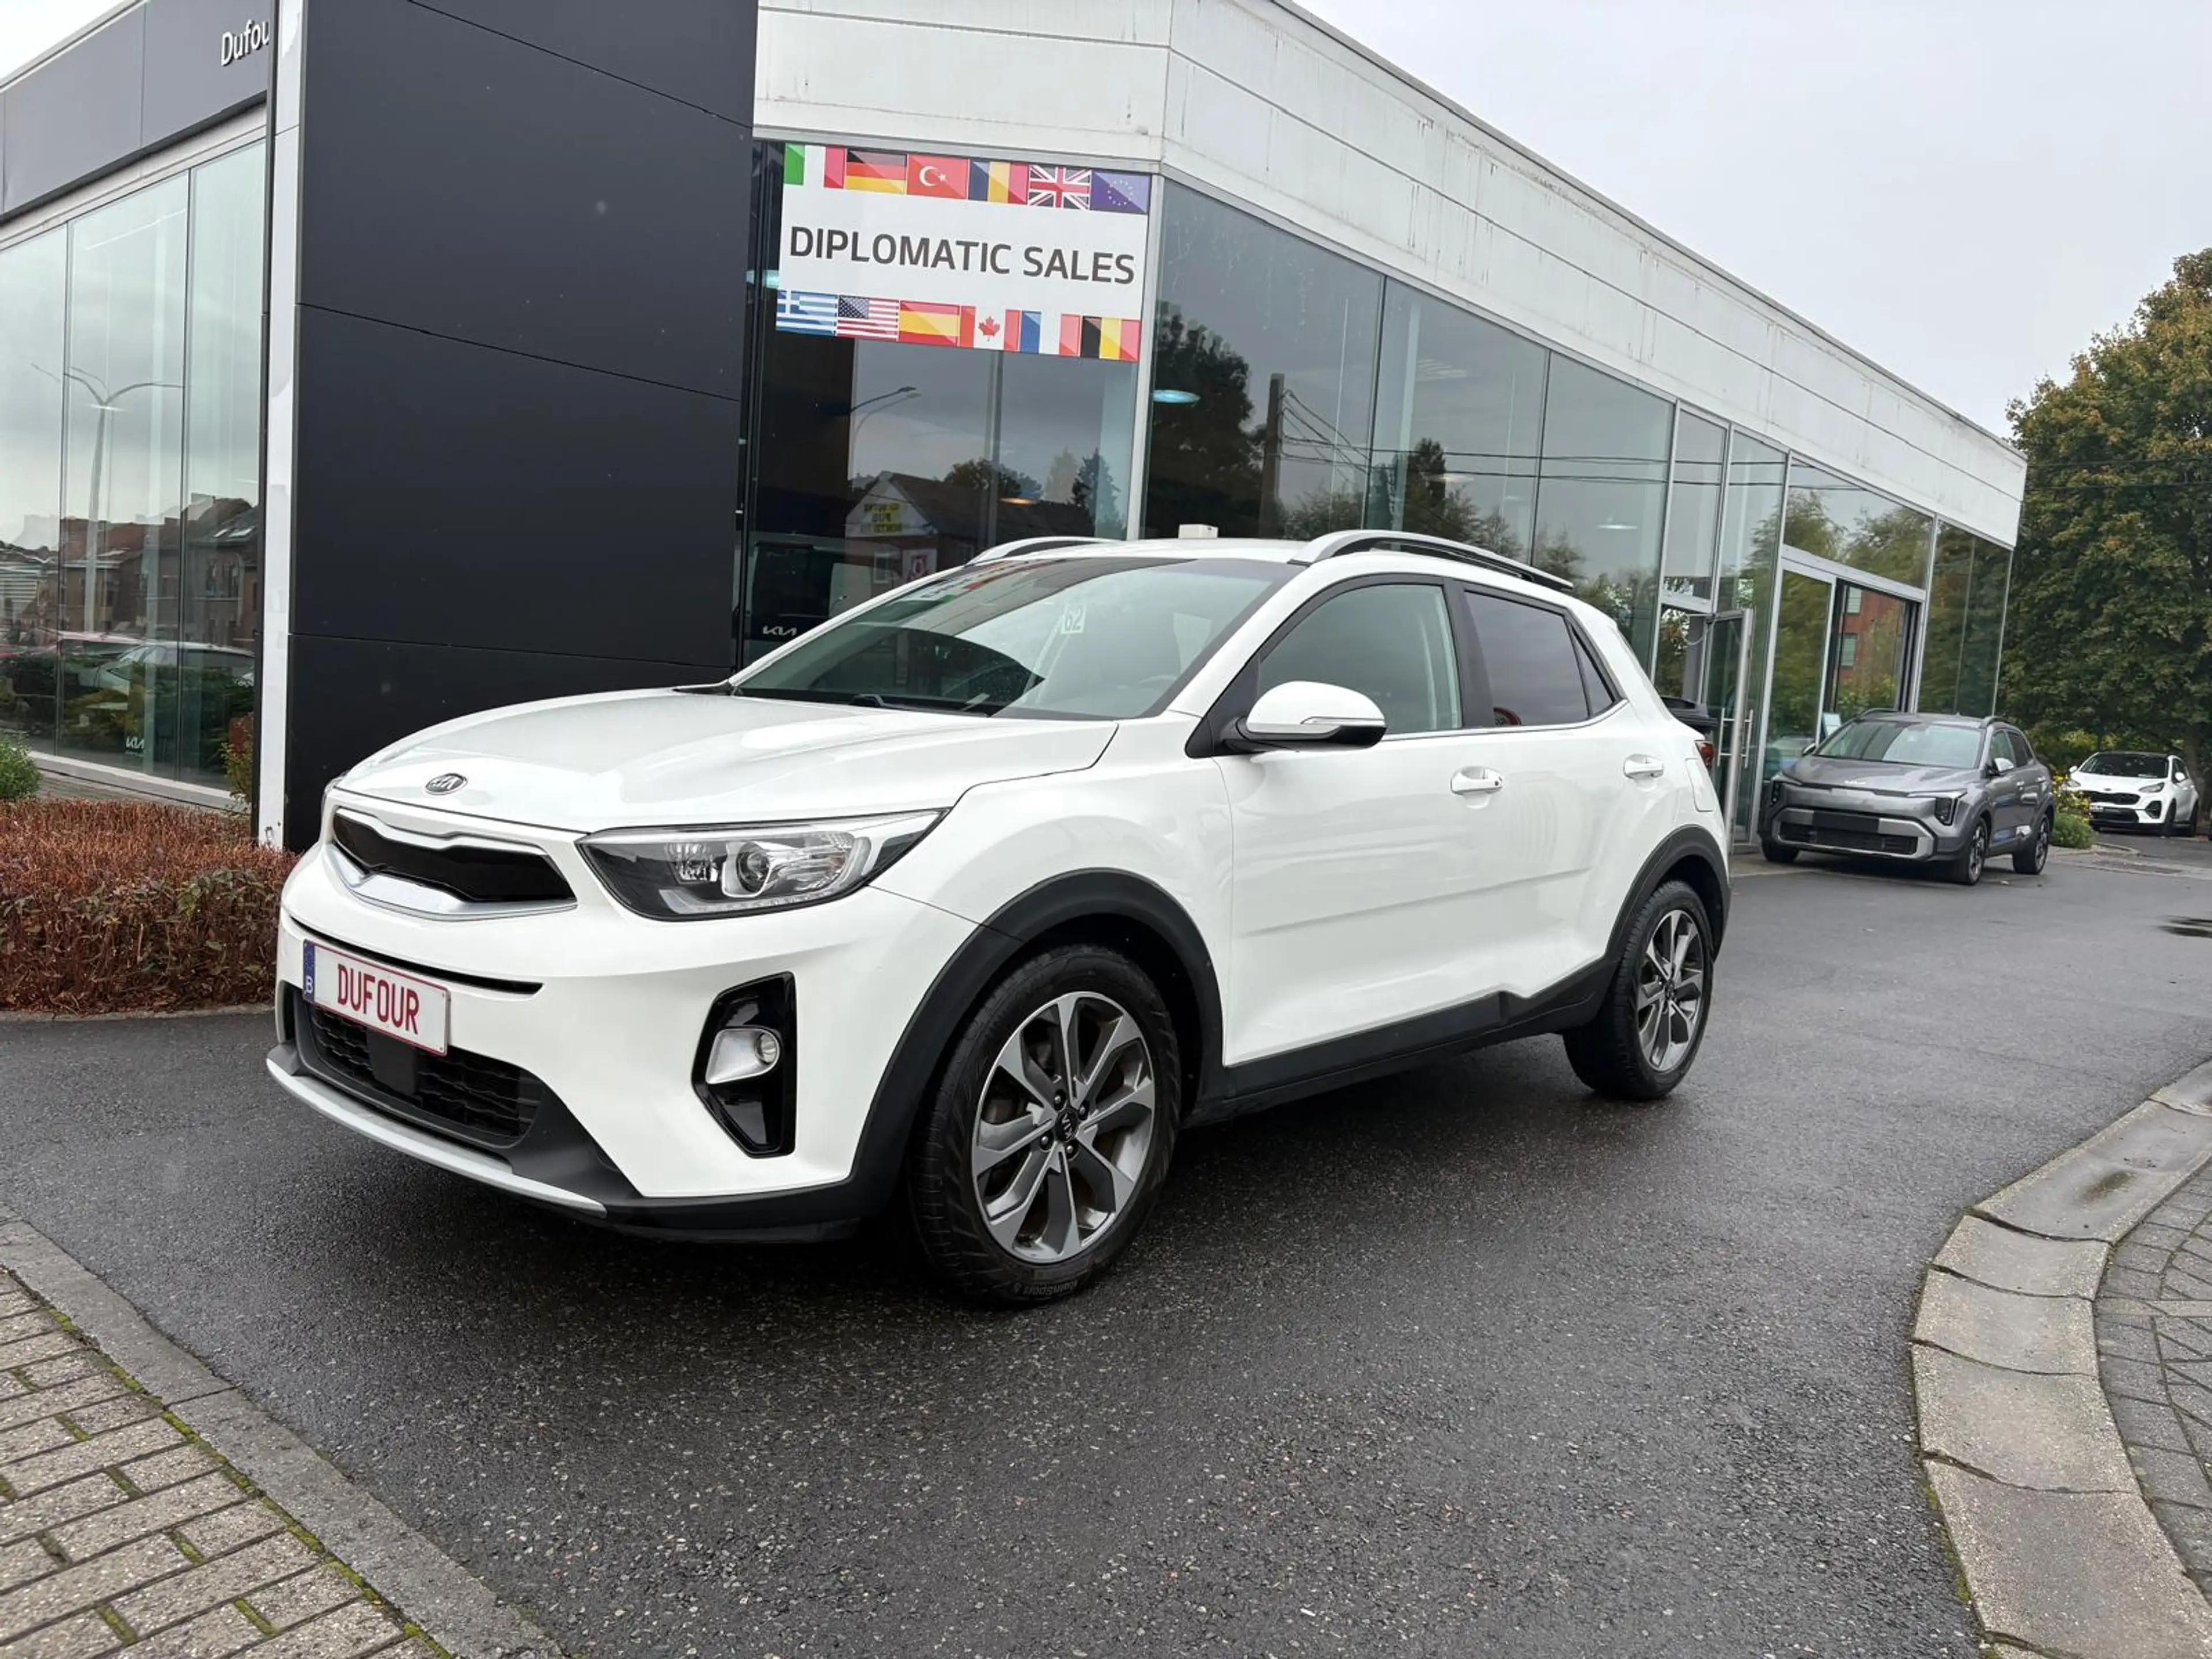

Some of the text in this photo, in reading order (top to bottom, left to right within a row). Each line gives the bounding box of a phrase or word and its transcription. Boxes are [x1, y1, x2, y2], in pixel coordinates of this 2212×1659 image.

[790, 226, 1134, 284] DIPLOMATIC SALES
[305, 975, 313, 995] B
[337, 963, 420, 1035] DUFOUR
